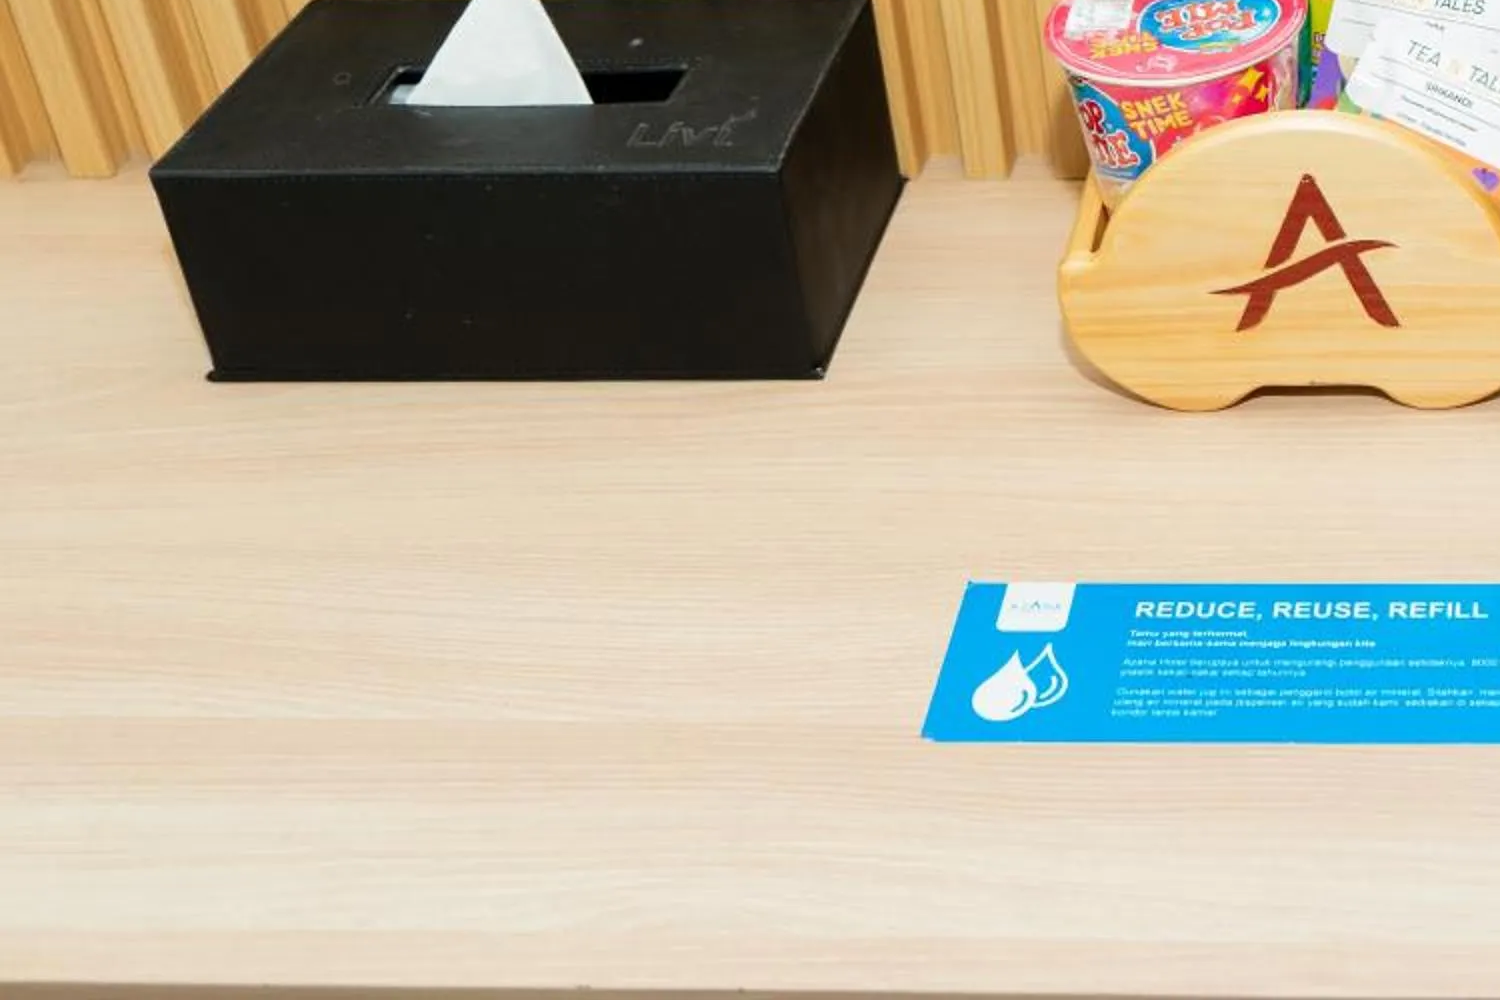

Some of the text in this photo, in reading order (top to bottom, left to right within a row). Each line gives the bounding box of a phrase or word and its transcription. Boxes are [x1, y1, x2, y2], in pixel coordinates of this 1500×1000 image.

[1406, 39, 1442, 67] TEA
[1119, 91, 1188, 121] SNEK
[1130, 110, 1194, 140] TIME
[1134, 601, 1489, 622] REDUCE, REUSE, REFILL
